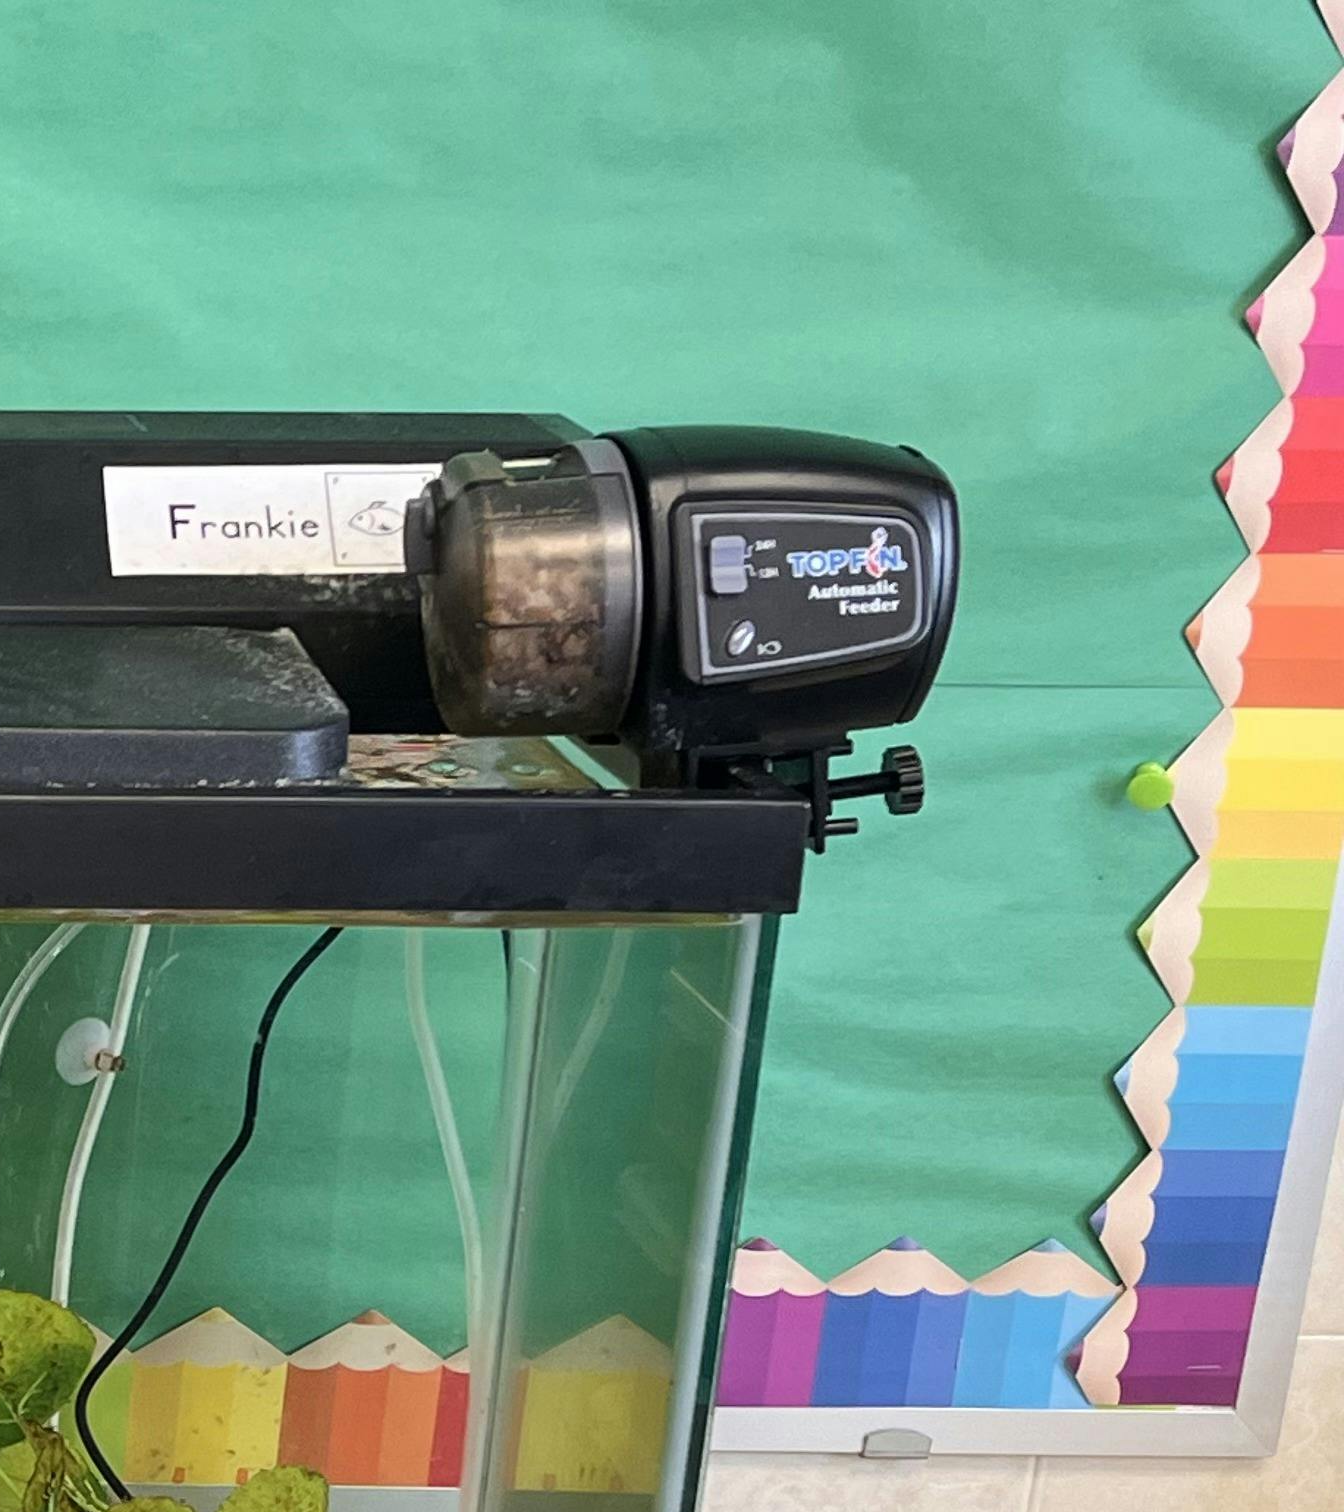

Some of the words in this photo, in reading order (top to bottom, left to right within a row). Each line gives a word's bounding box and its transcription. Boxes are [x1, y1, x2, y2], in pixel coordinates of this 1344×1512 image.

[168, 503, 320, 540] Frankie
[808, 580, 899, 600] Automatic
[839, 597, 900, 615] Feeder
